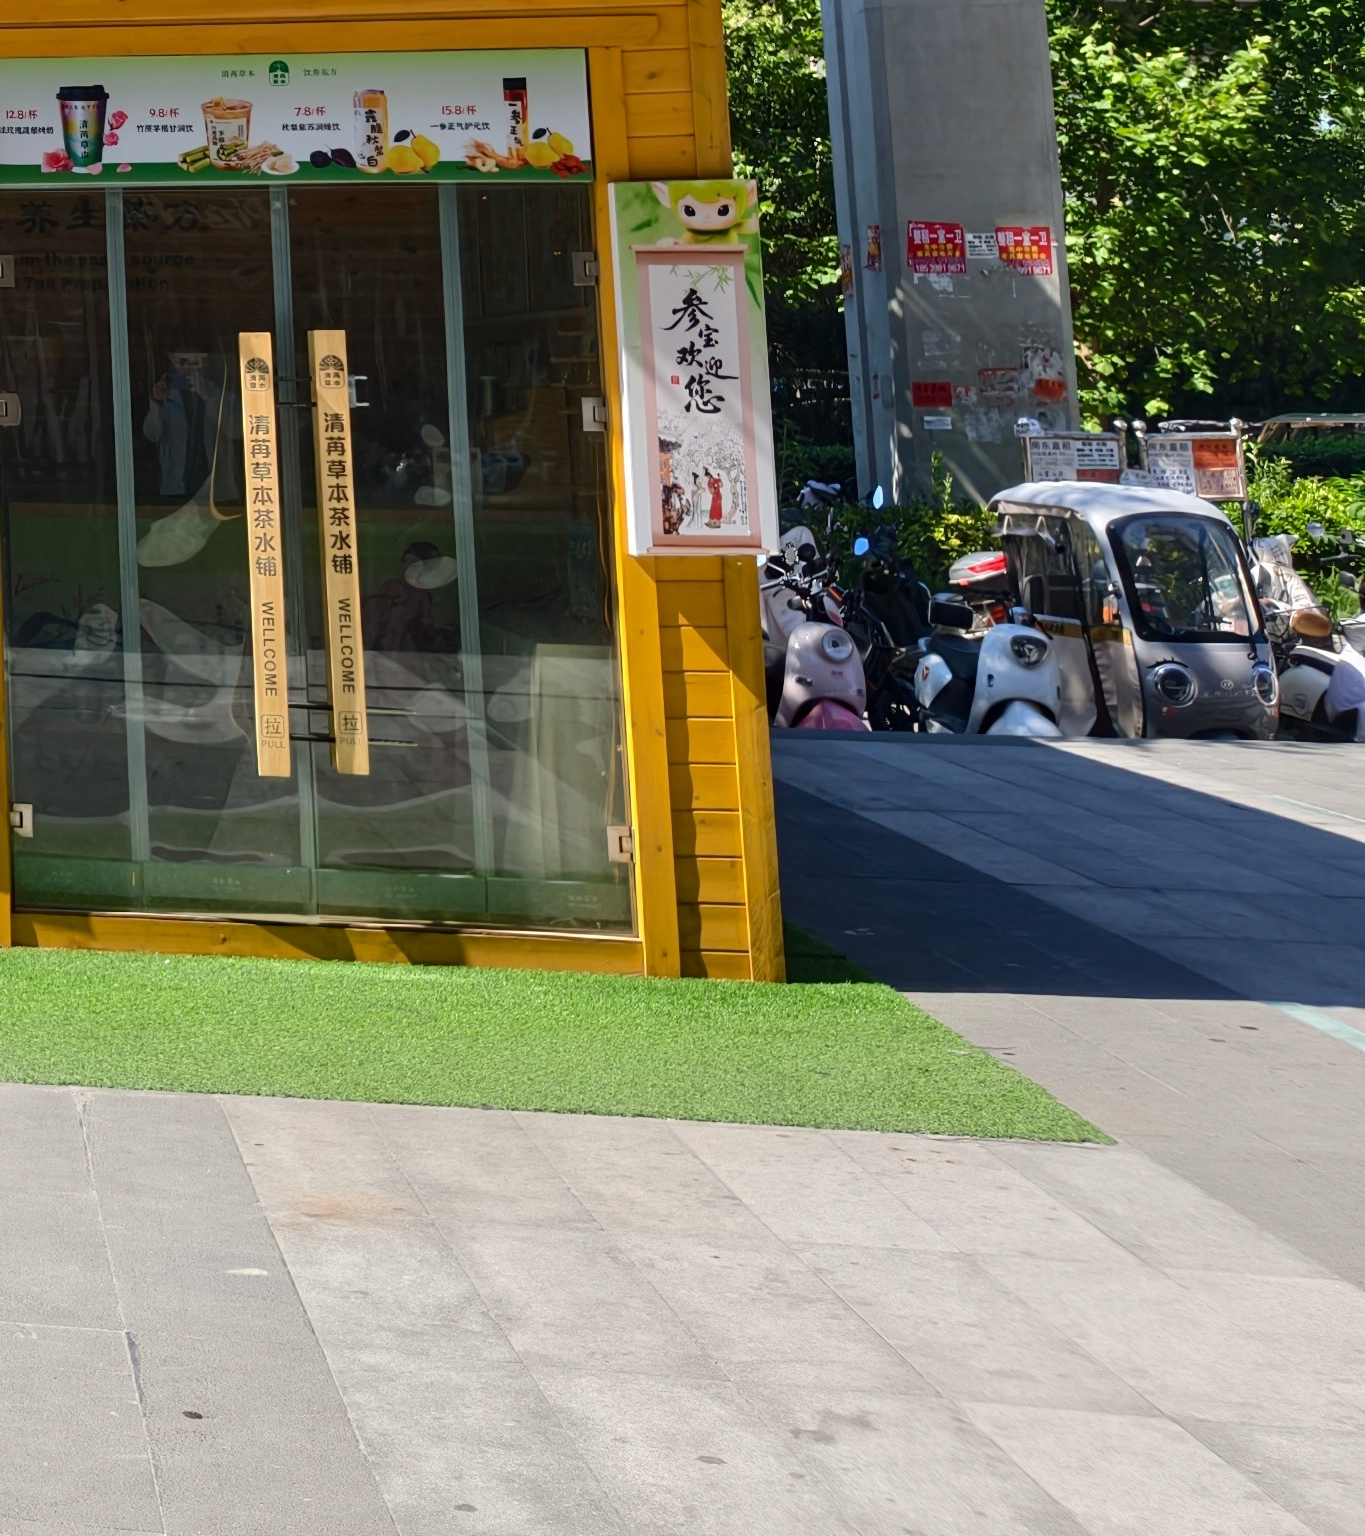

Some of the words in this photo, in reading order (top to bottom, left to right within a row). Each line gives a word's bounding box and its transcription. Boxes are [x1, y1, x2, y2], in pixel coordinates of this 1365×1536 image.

[5, 109, 38, 120] 12.8/杯
[149, 108, 180, 119] 9.8/杯
[294, 106, 326, 117] 7.8/杯
[441, 104, 477, 115] 15.8/杯
[261, 601, 278, 697] WELLCOME
[338, 598, 355, 694] WELLCOME
[264, 718, 282, 735] 拉
[342, 714, 360, 731] 拉
[261, 740, 286, 749] PULL
